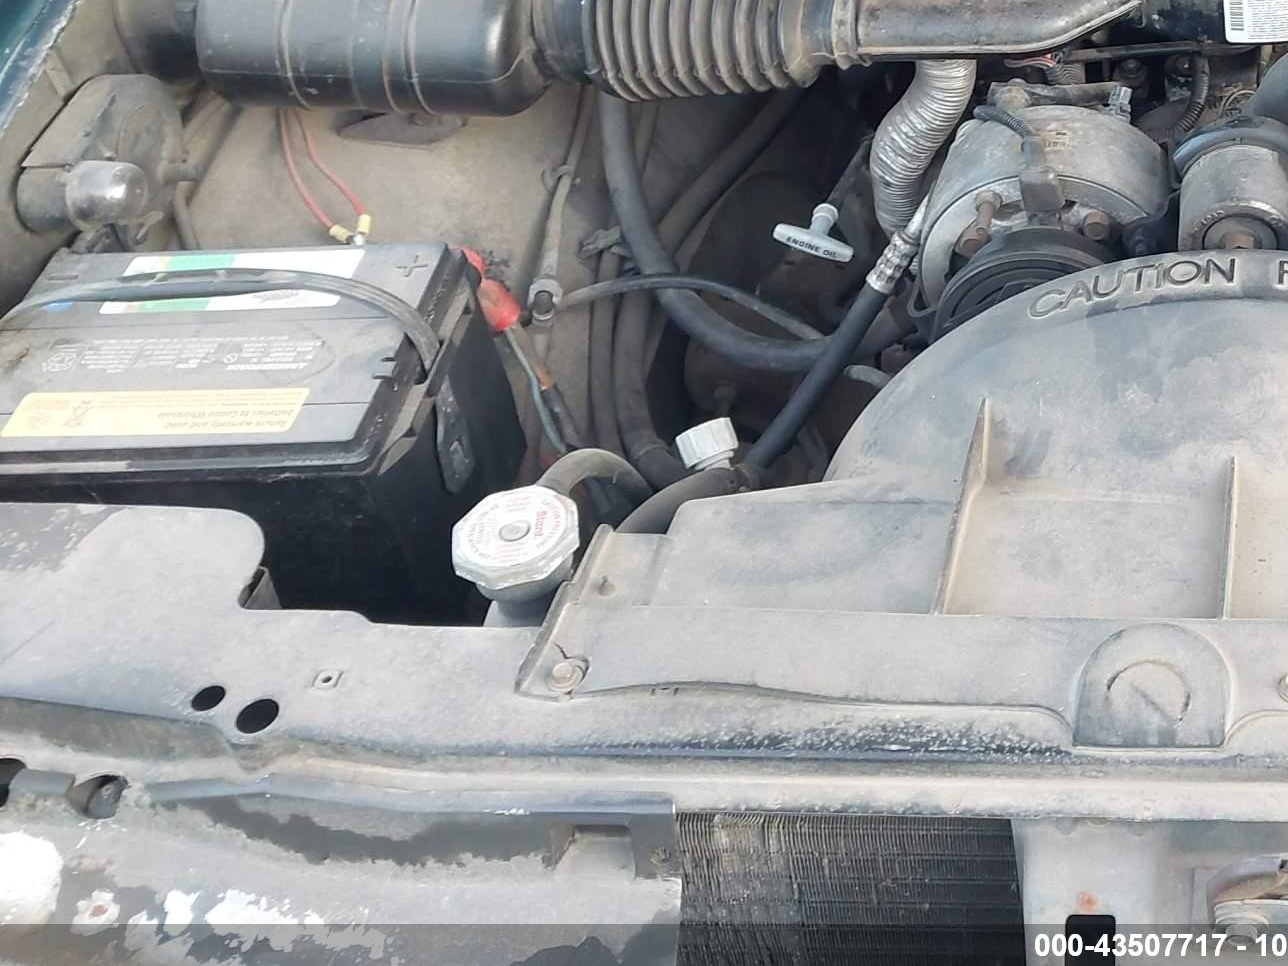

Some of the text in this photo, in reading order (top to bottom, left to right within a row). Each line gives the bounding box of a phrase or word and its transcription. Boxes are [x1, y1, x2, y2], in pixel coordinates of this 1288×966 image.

[785, 236, 838, 258] ENGINE OIL
[1028, 257, 1237, 319] CAUTION
